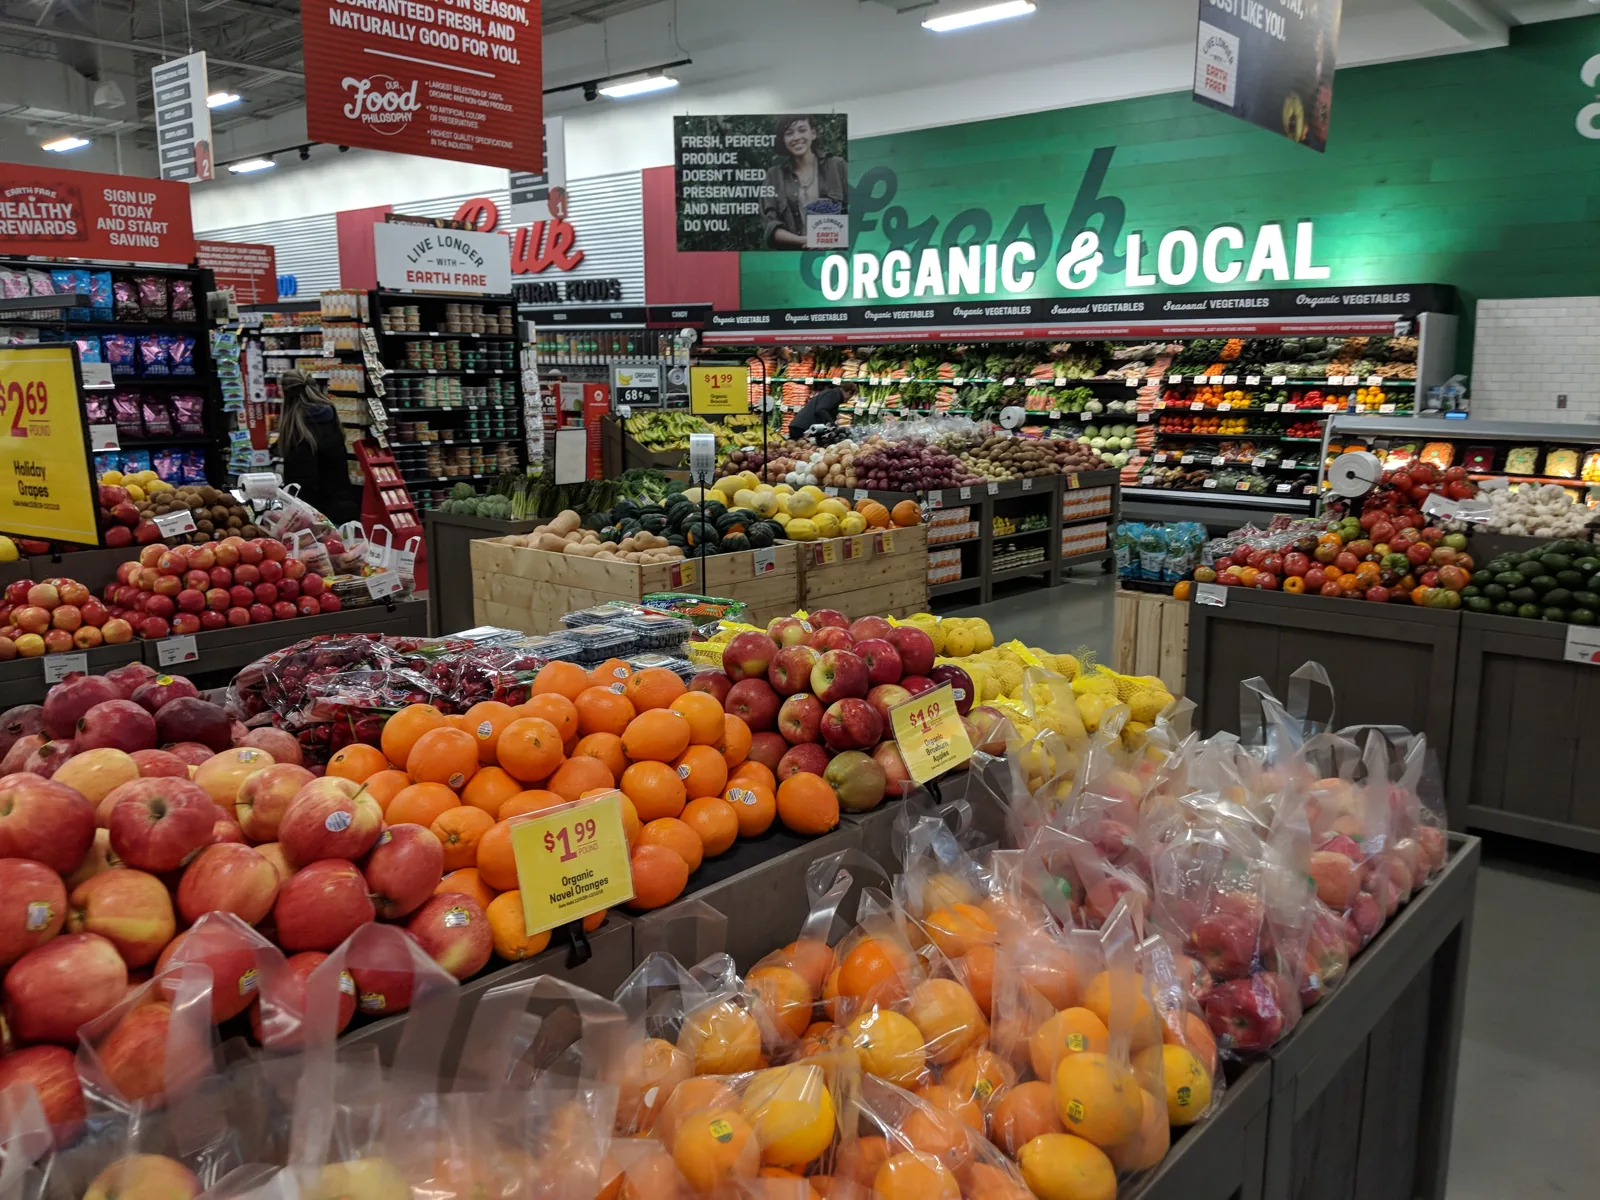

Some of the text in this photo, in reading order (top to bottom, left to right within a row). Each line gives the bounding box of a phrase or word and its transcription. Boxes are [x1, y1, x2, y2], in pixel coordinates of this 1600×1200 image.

[473, 0, 529, 26] SEASON,
[336, 0, 515, 41] UARANTEED FRESH, AND
[1240, 0, 1263, 29] LIKE
[1265, 8, 1287, 42] YOU.
[329, 8, 520, 64] NATURALLY GOOD FOR YOU.
[385, 81, 400, 90] OUR
[341, 76, 422, 119] Food
[361, 111, 413, 124] PHILOSOPHY
[681, 135, 777, 149] FRESH, PERFECT
[682, 152, 738, 165] PRODUCE
[202, 159, 210, 177] 2
[682, 169, 767, 182] DOESN'T NEED
[5, 186, 57, 199] EARTH FARE
[103, 188, 157, 205] SIGN UP
[683, 186, 779, 198] PRESERVATIVES.
[109, 204, 154, 219] TODAY
[556, 202, 564, 216] 1
[683, 203, 760, 215] AND NEITHER
[0, 219, 78, 235] REWARDS
[97, 217, 168, 235] AND START
[684, 219, 730, 231] DO YOU.
[109, 232, 159, 248] SAVING
[407, 235, 484, 268] LIVE LONGER
[436, 258, 457, 267] WITH
[821, 221, 1331, 301] ORGANIC & LOCAL
[406, 270, 487, 287] EARTH FARE
[511, 278, 622, 303] TURAL FOODS
[1163, 298, 1269, 311] Seasonal VEGETABLES
[1296, 293, 1411, 306] Organic VEGETABLES
[864, 310, 934, 320] Organic VEGETABLES
[953, 306, 1031, 317] Organic VEGETABLES
[1051, 302, 1145, 315] Seasonal VEGETABLES
[713, 315, 771, 325] Organic VEGETABLES
[785, 312, 848, 324] Organic VEGETABLES
[13, 460, 46, 481] Holiday
[18, 480, 49, 500] Grapes
[924, 733, 944, 747] Organic
[932, 750, 950, 763] Apples
[578, 843, 599, 856] POUND
[561, 868, 594, 887] Organic
[549, 888, 574, 904] Navel
[575, 877, 609, 895] Oranges
